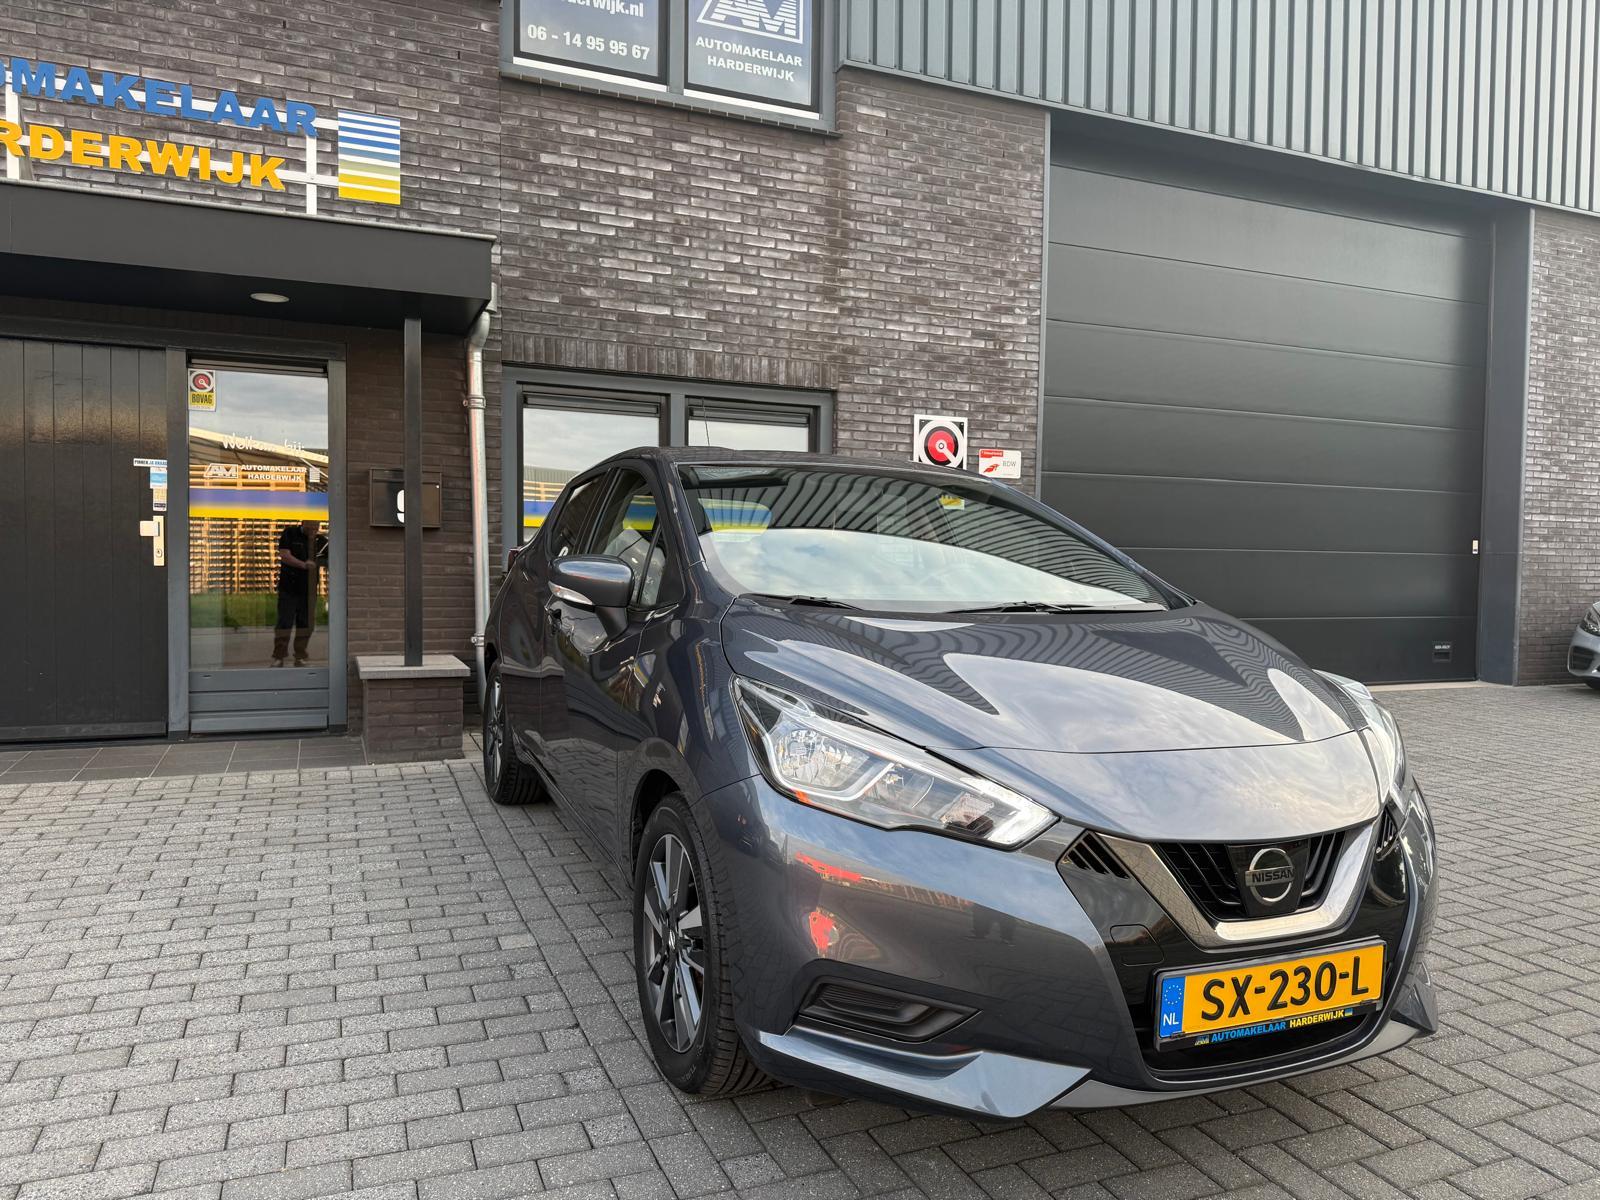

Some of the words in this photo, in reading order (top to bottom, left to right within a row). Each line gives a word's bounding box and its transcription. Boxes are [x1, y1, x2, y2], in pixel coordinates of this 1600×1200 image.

[527, 24, 547, 40] 06
[563, 31, 582, 47] 14
[586, 35, 605, 51] 95
[609, 40, 627, 56] 95
[631, 45, 650, 60] 67
[696, 36, 803, 66] AUTOMAKELAAR
[707, 55, 794, 82] HARDERWIJK
[0, 57, 319, 137] MAKELAAR
[0, 119, 285, 190] RDERWIJK
[191, 393, 213, 404] BOVAG
[241, 464, 307, 473] AUTOMAKELAAR
[248, 473, 302, 481] HARDERWIJK
[1252, 869, 1294, 883] NISSAN
[1201, 956, 1369, 1021] SX-230-L
[1163, 1012, 1179, 1026] NL
[1211, 1022, 1286, 1043] AUTOMAKELAAR
[1289, 1009, 1345, 1028] HARDERWIJK
